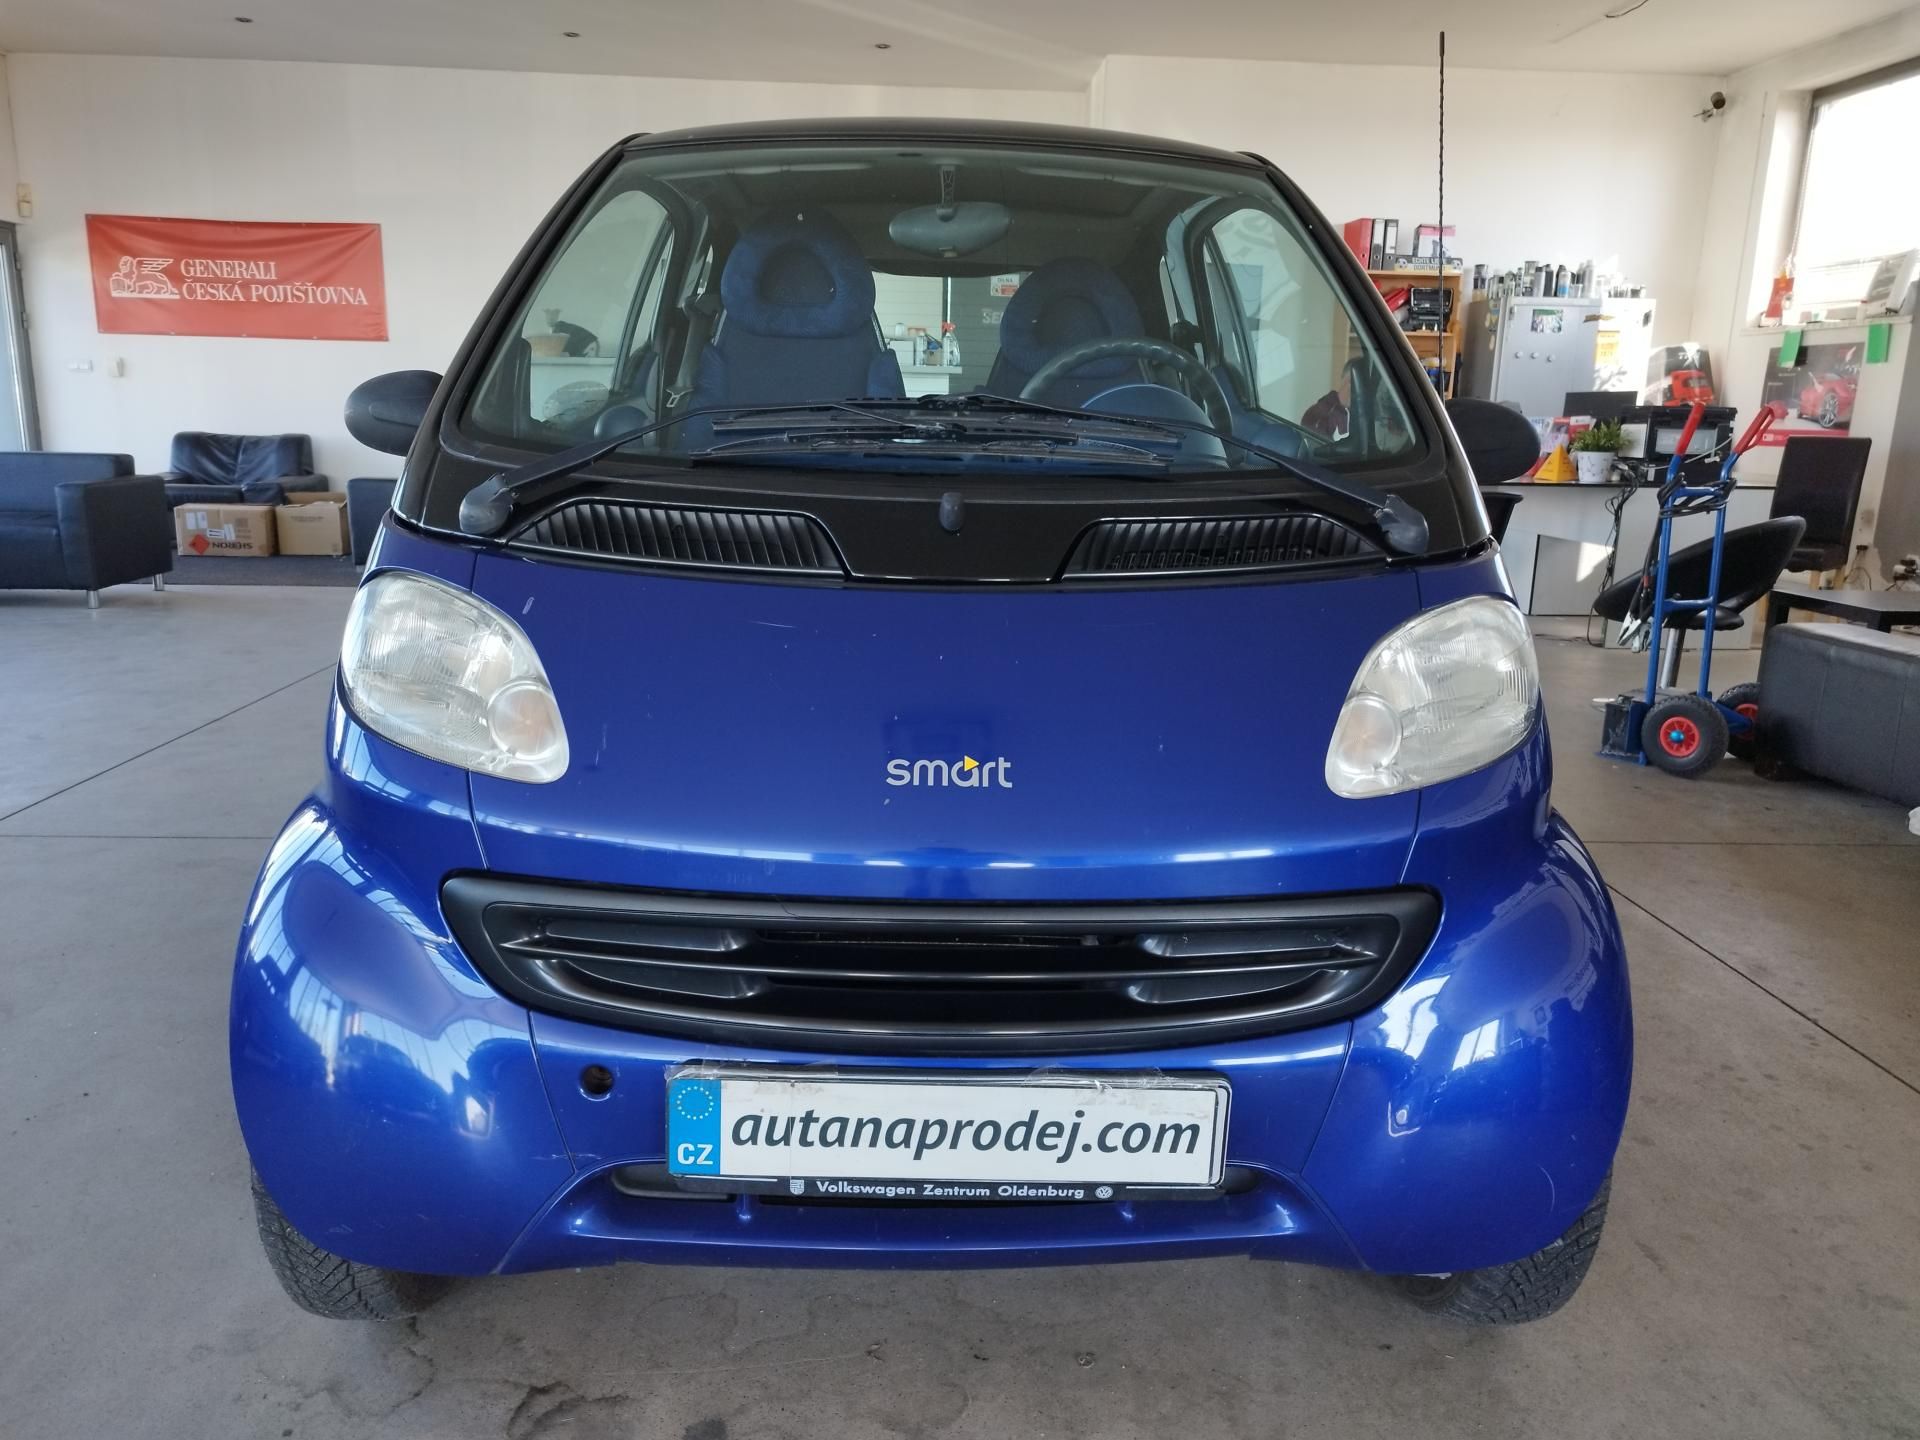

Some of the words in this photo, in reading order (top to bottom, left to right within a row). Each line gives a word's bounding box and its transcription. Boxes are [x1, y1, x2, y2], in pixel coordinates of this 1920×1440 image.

[180, 258, 277, 280] GENERALI
[182, 279, 246, 302] ČESKÁ
[250, 281, 368, 305] POJIŠŤOVNA
[886, 755, 1013, 788] smart
[731, 1109, 1201, 1163] autanaprodej.com
[677, 1143, 714, 1165] CZ
[816, 1181, 916, 1197] Volkswagen
[923, 1184, 990, 1197] Zentrum
[997, 1185, 1085, 1199] Oldenburg
